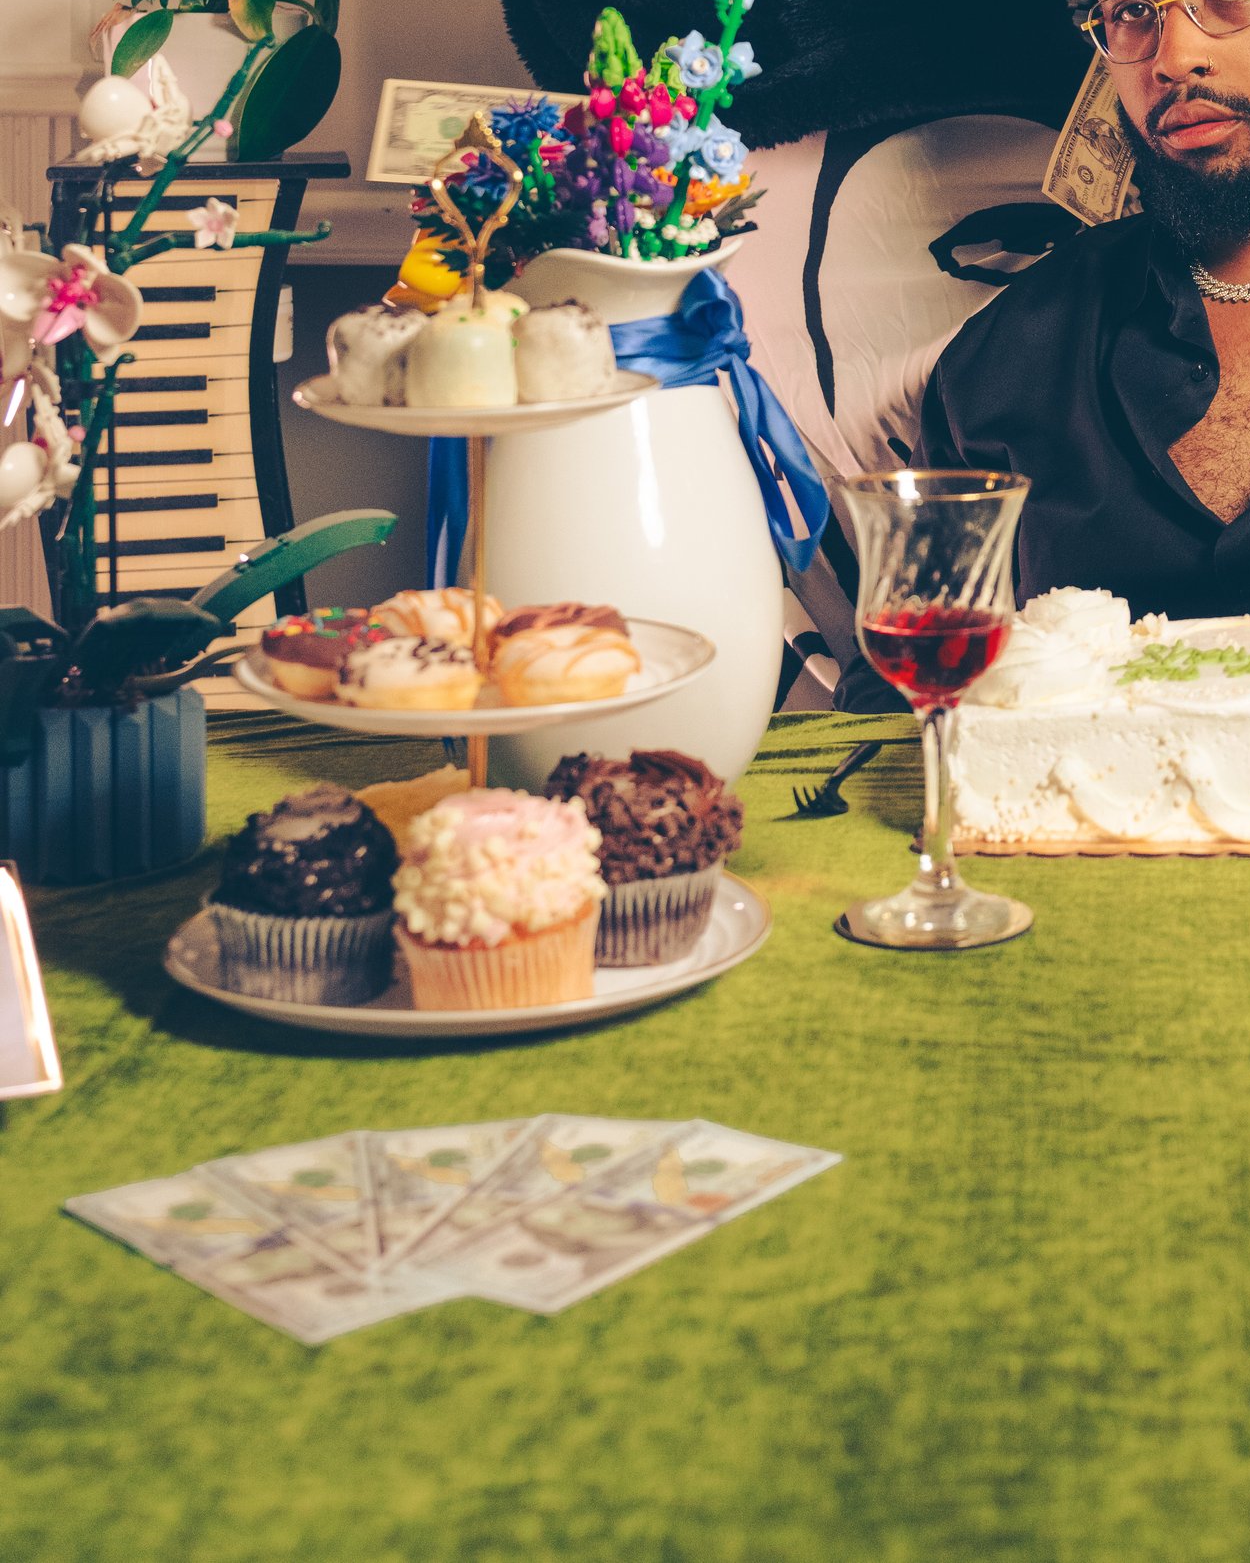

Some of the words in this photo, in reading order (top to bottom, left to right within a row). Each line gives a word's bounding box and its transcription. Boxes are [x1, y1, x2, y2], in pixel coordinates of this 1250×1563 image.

[1062, 134, 1077, 164] UNITED
[1060, 164, 1070, 179] THE
[1080, 185, 1091, 205] COPY
